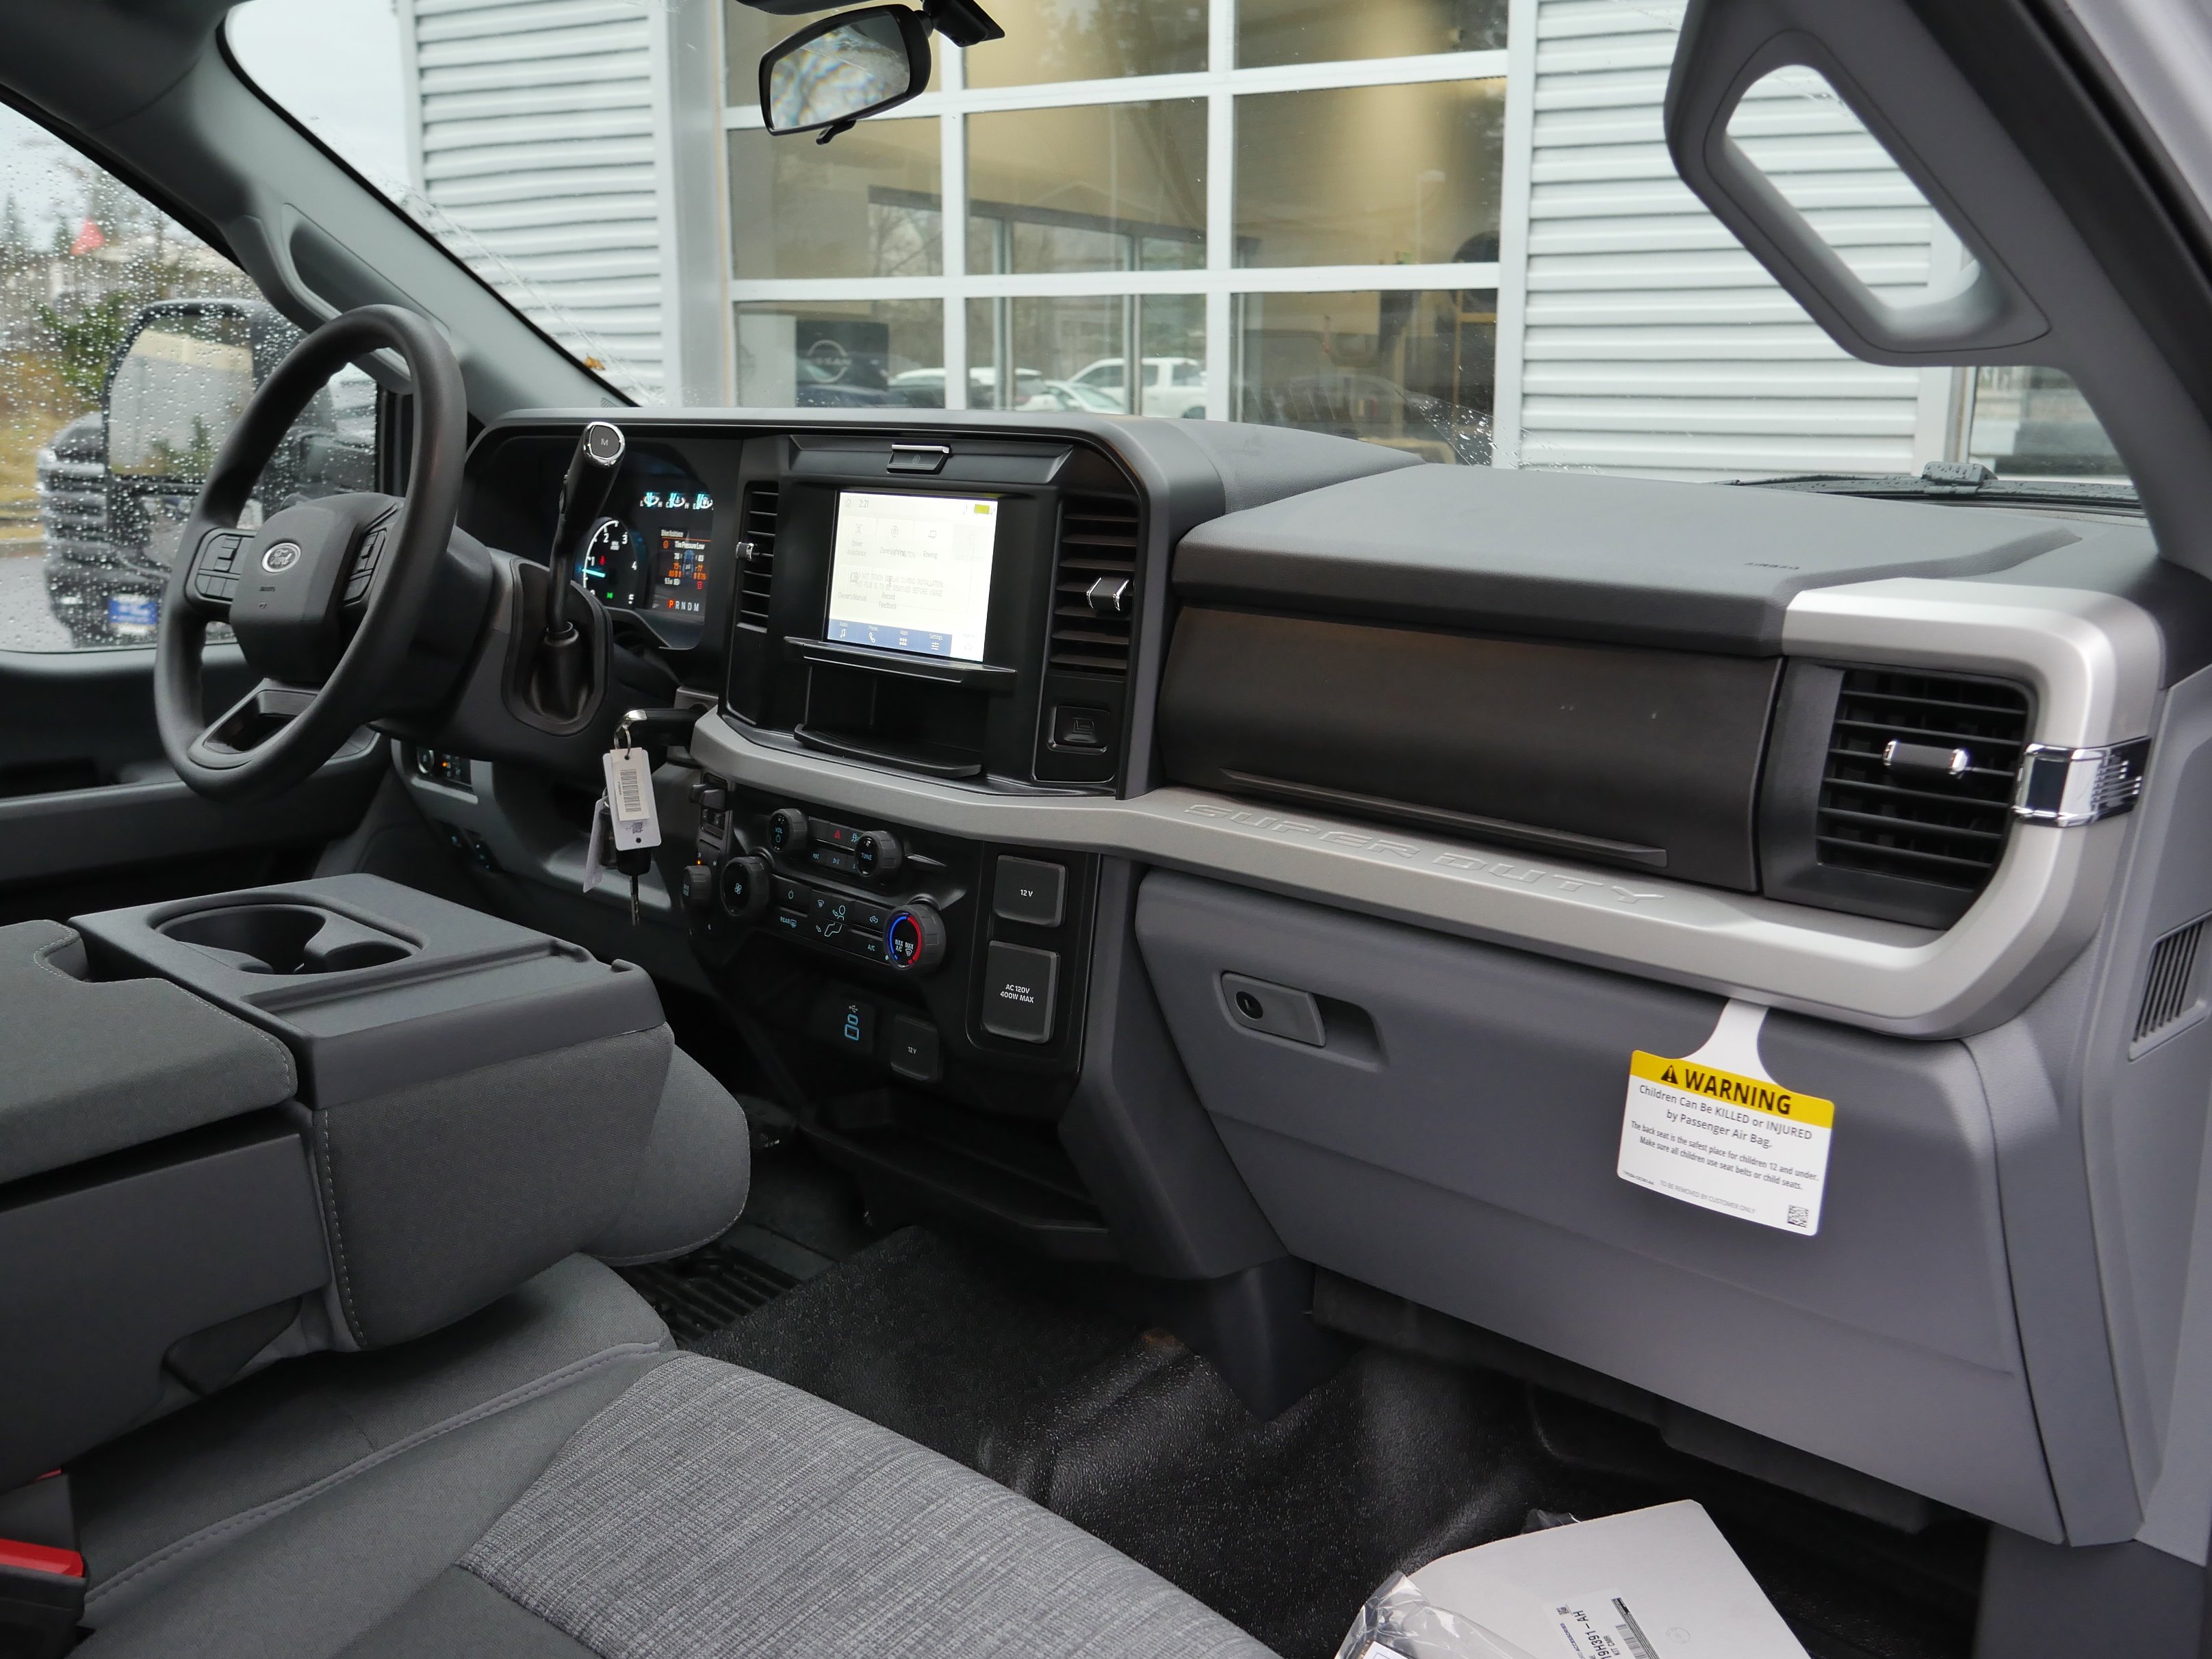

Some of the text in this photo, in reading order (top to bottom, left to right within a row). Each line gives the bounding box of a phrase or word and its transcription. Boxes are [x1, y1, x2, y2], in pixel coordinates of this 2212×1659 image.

[601, 438, 608, 446] M
[603, 532, 628, 544] 2 3
[631, 561, 637, 571] 4
[675, 601, 679, 609] R
[681, 602, 686, 610] N
[688, 602, 693, 610] D
[861, 851, 872, 861] TUNE
[1183, 802, 1665, 905] SUPER DUTY
[780, 916, 790, 924] REAR
[867, 943, 875, 952] A/C
[1014, 985, 1030, 994] 120V
[1000, 990, 1034, 1003] 400W MAX
[1685, 1068, 1792, 1115] WARNING
[1639, 1084, 1812, 1140] Children Can Be KILLED or INJURED
[1666, 1109, 1773, 1149] by Passenger Air Bag.
[1631, 1120, 1820, 1181] The back seat is the safest place for children 12 and under.
[1640, 1136, 1803, 1190] Make sure all children use seat belts or child seats.
[1675, 1185, 1699, 1198] REMOVED
[1709, 1196, 1739, 1209] CUSTOMER
[1573, 1610, 1589, 1621] AH
[1560, 1623, 1580, 1651] ACCESSORIES
